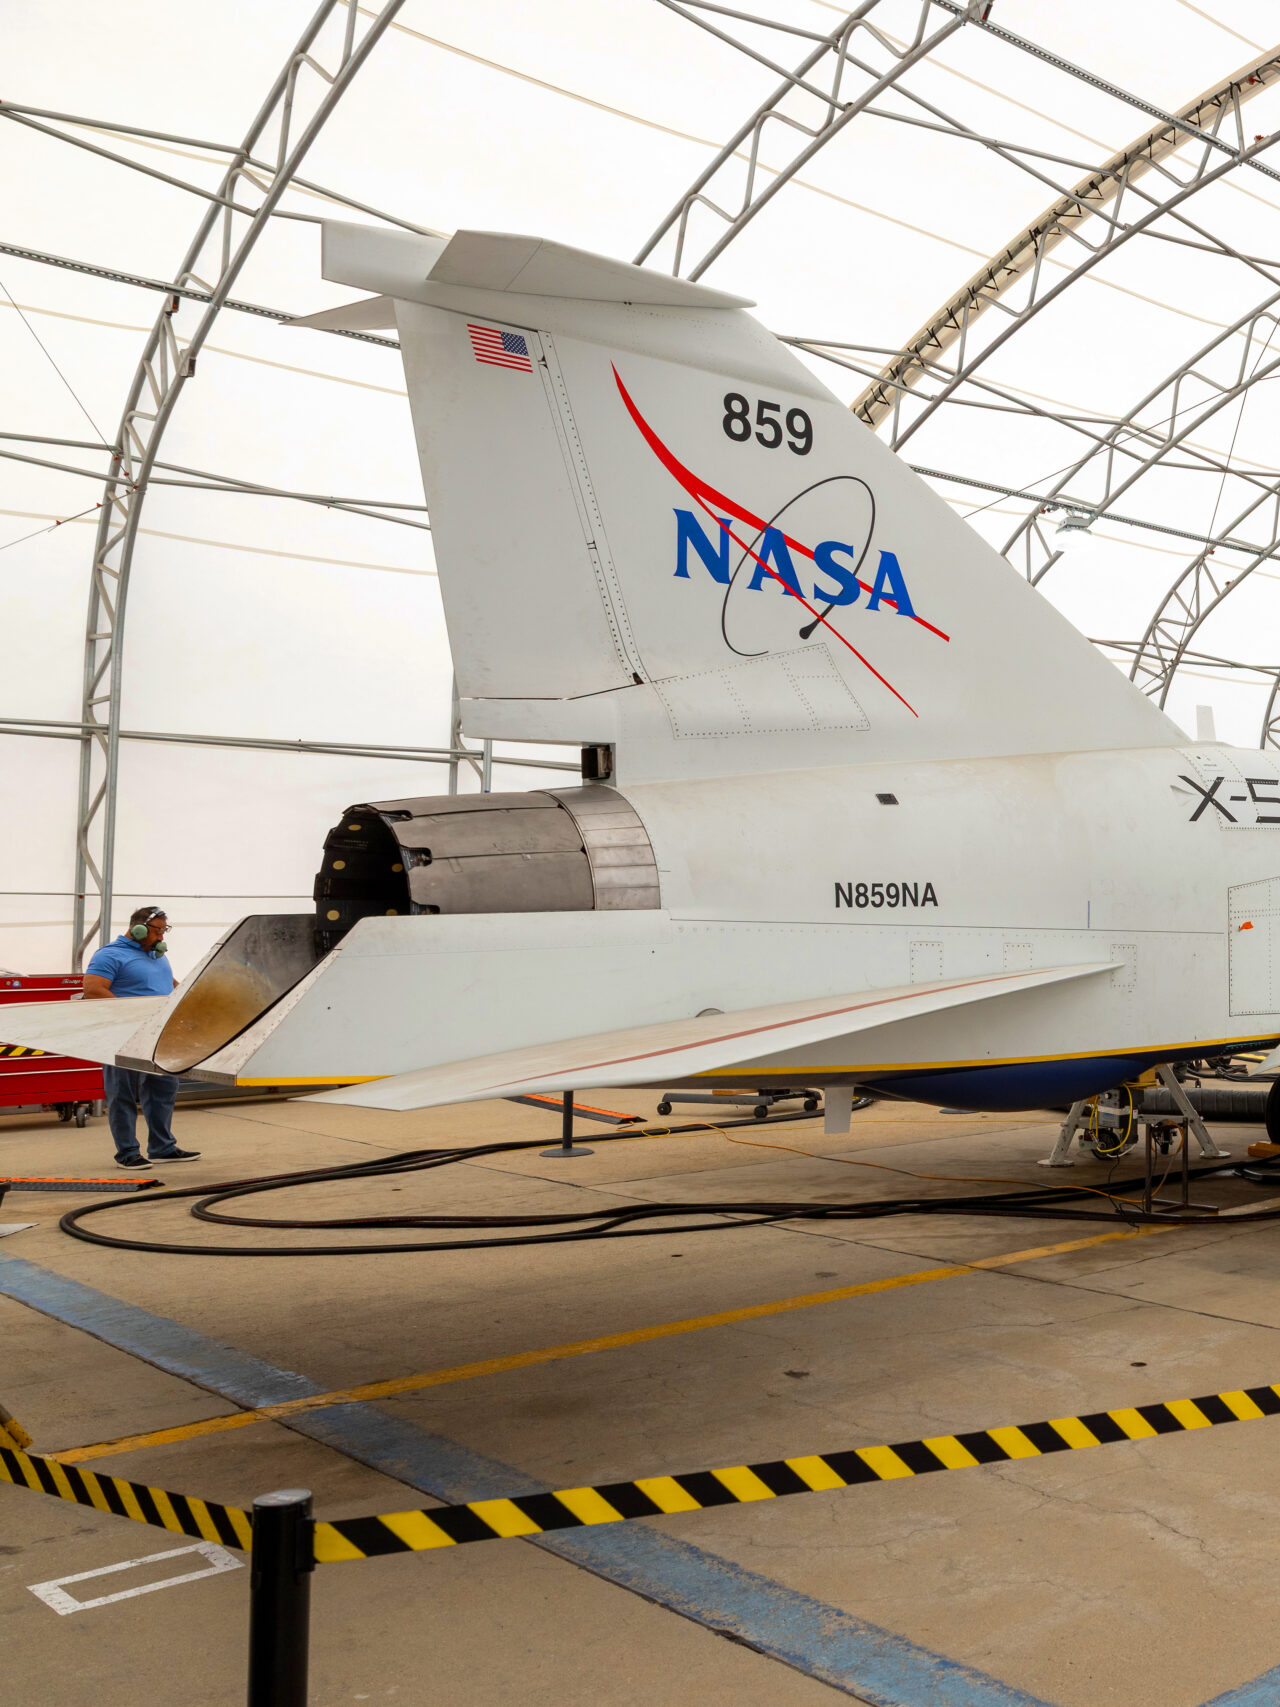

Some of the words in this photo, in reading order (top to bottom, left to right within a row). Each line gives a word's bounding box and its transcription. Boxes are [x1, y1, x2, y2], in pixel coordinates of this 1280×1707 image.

[722, 392, 814, 456] 859
[673, 508, 918, 618] NASA
[834, 882, 939, 908] N859NA
